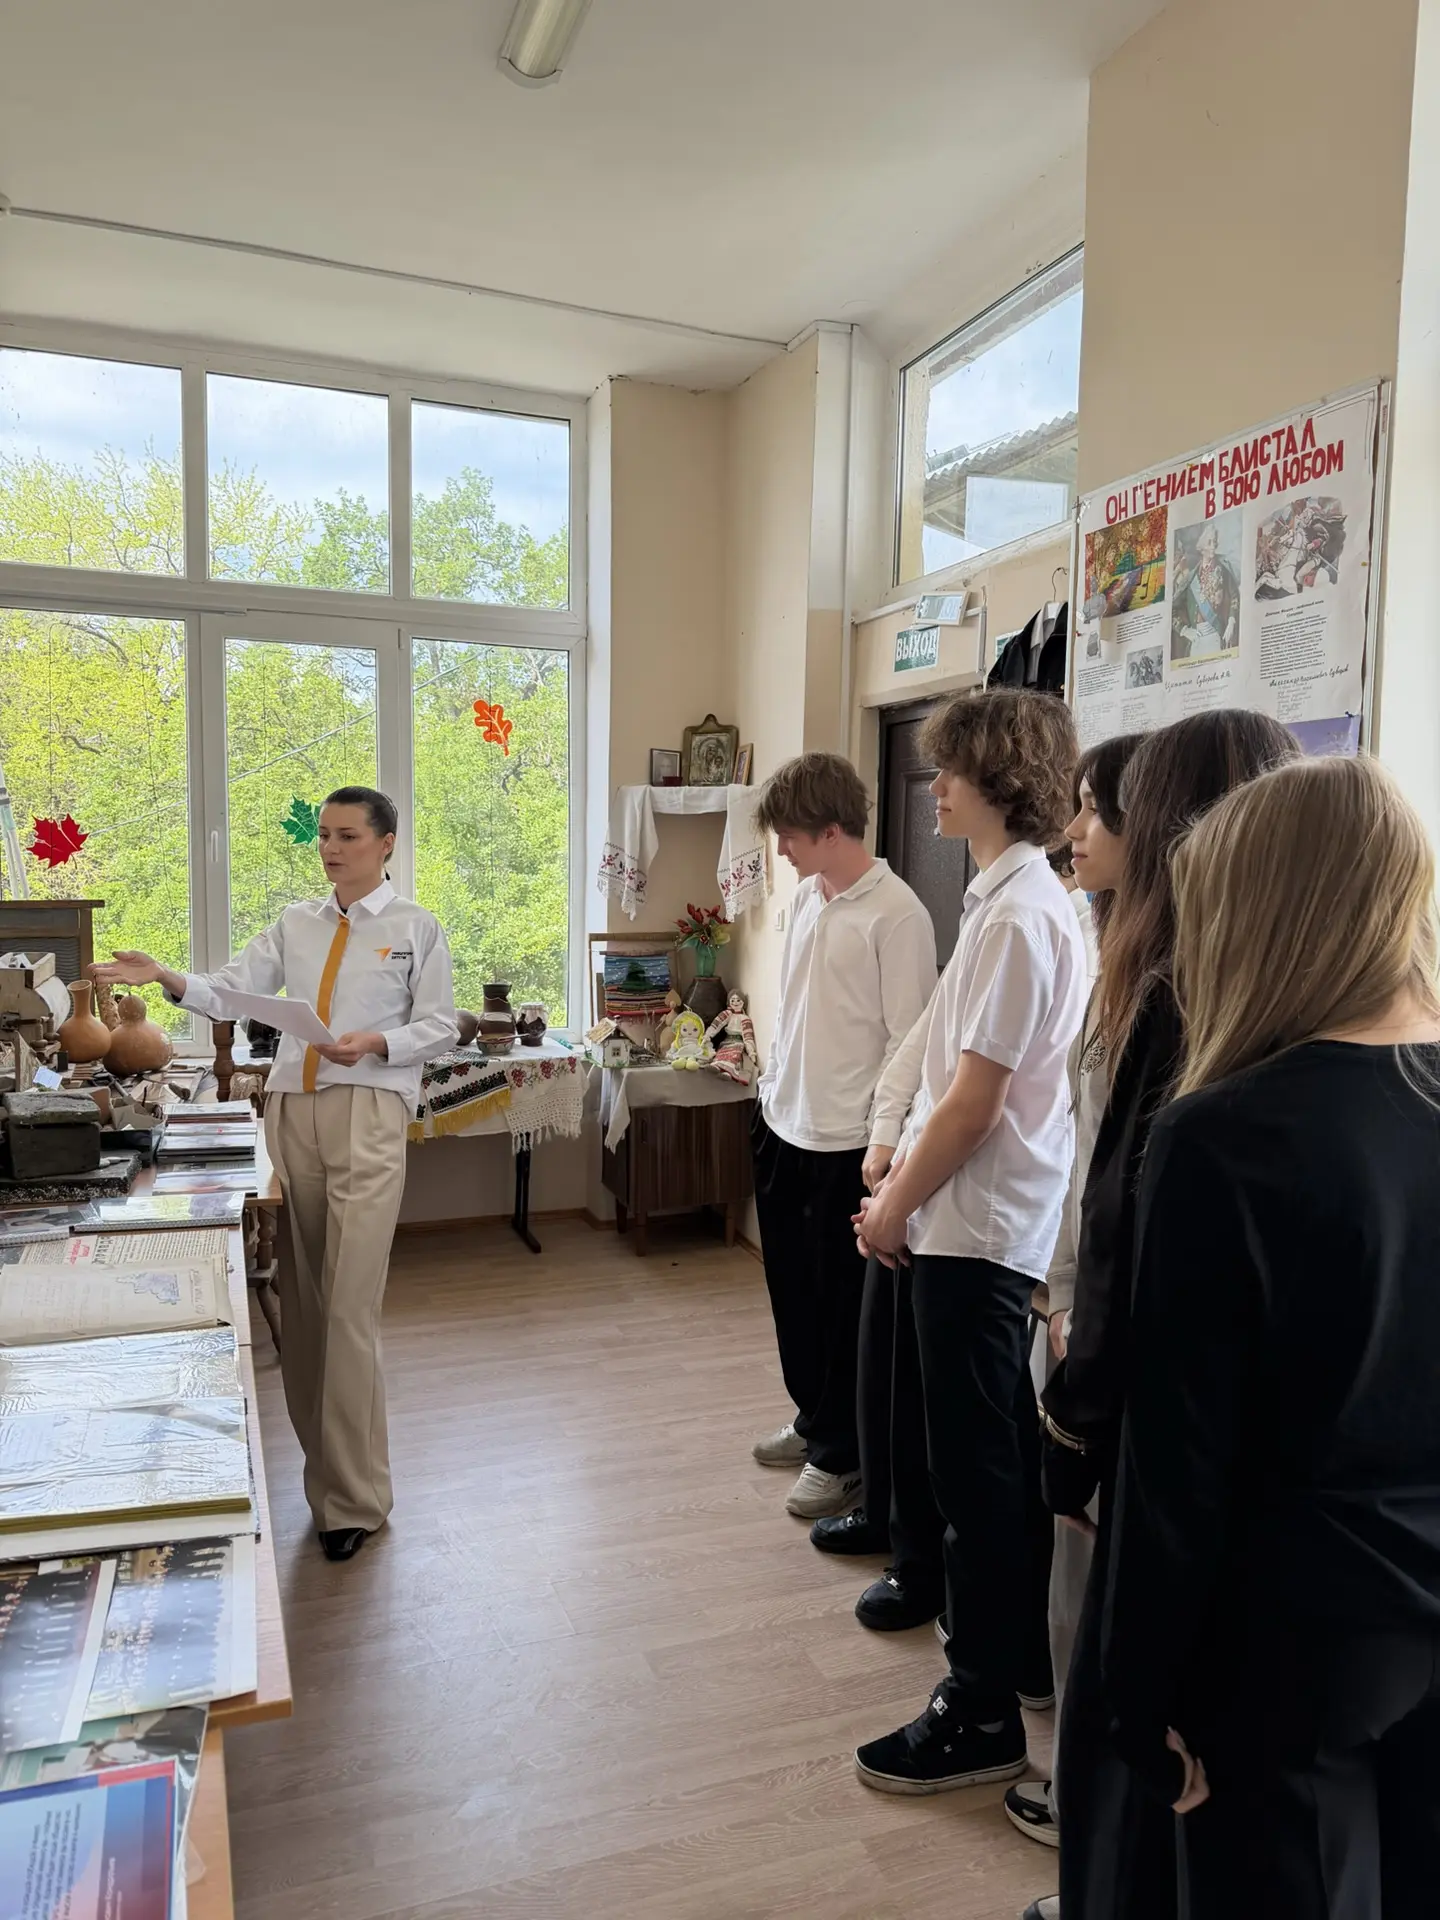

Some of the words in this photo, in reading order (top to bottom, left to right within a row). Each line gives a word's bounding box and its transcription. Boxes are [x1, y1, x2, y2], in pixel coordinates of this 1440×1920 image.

[1106, 490, 1128, 524] ОН
[1132, 458, 1214, 514] ГЕНИЕМ
[1218, 418, 1316, 483] БЛИСТАЛ
[1205, 488, 1216, 519] В
[1223, 470, 1261, 510] БОЮ
[1267, 440, 1344, 495] ЛЮБОМ
[896, 629, 938, 662] ВЫХОД
